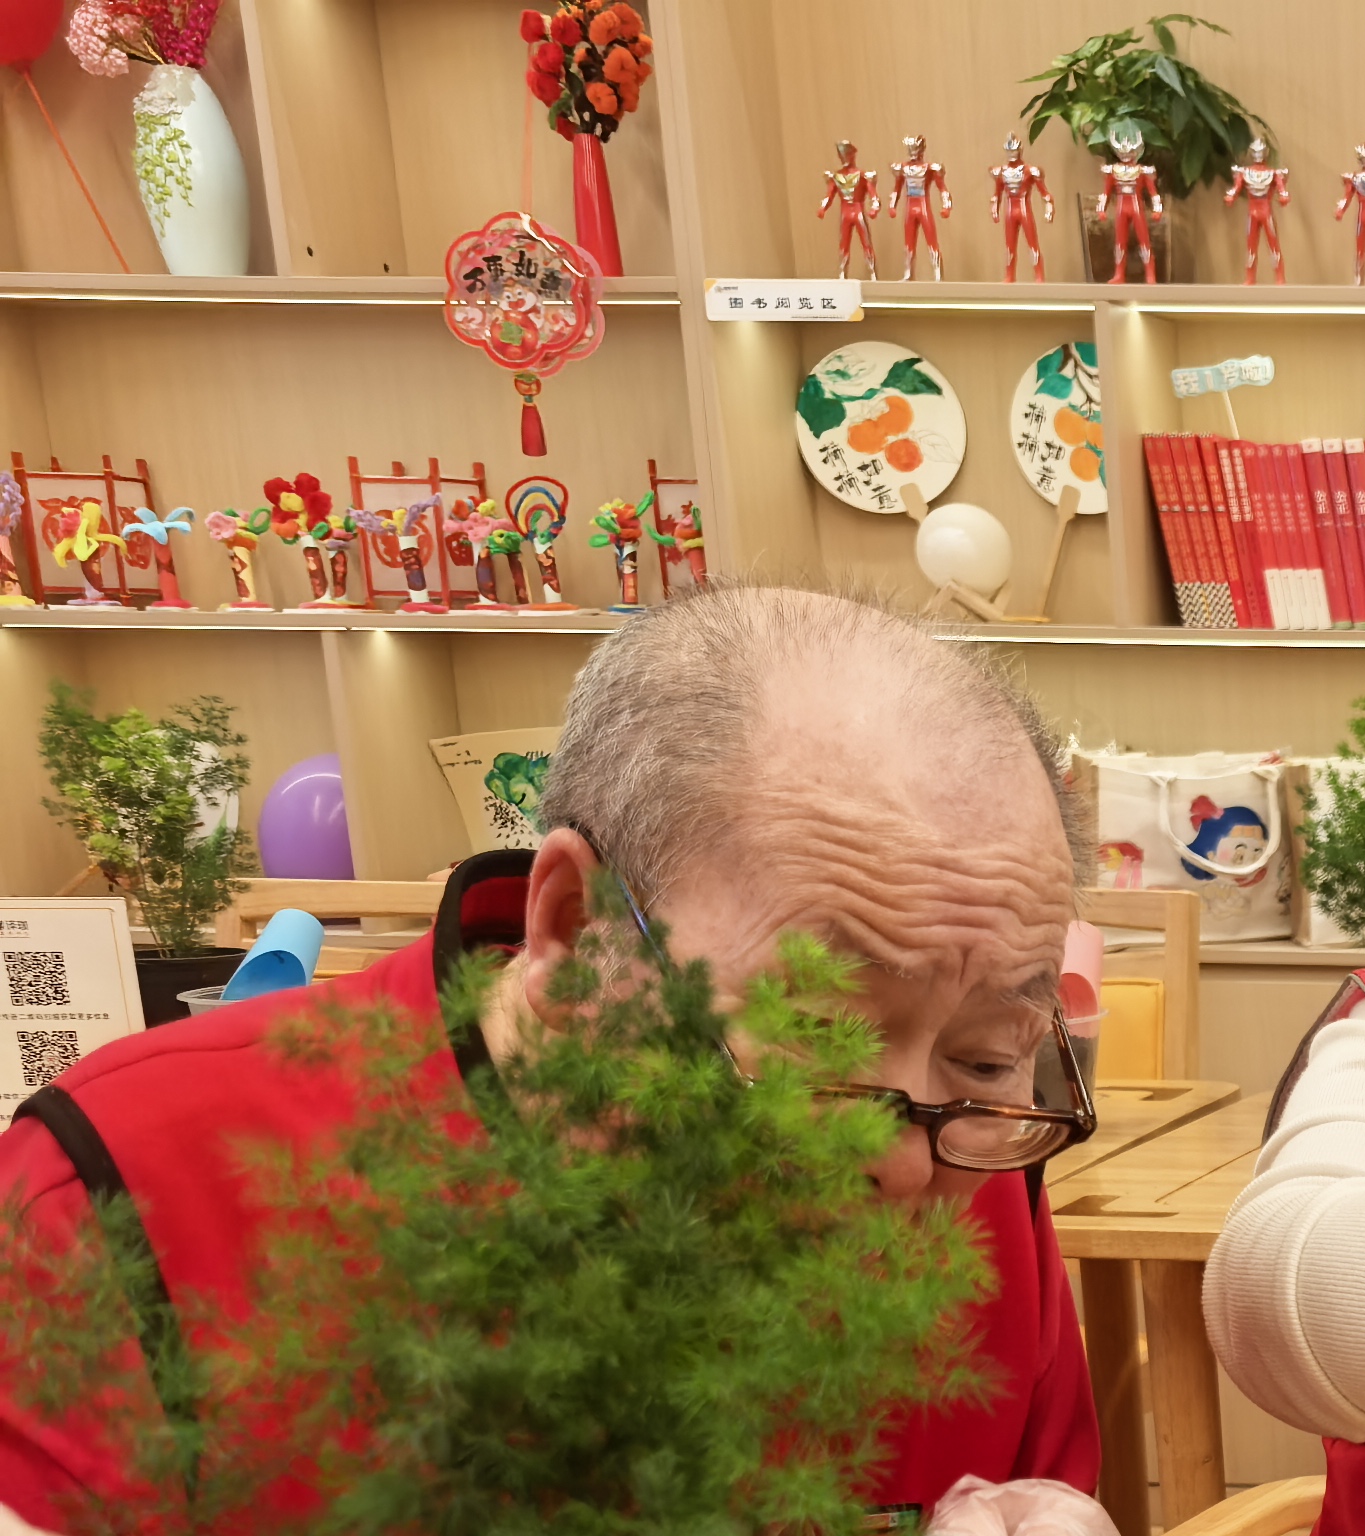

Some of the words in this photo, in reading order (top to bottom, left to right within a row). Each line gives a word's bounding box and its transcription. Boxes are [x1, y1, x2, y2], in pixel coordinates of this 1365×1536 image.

[463, 250, 562, 299] 万事如意
[728, 296, 838, 310] 图书阅览区
